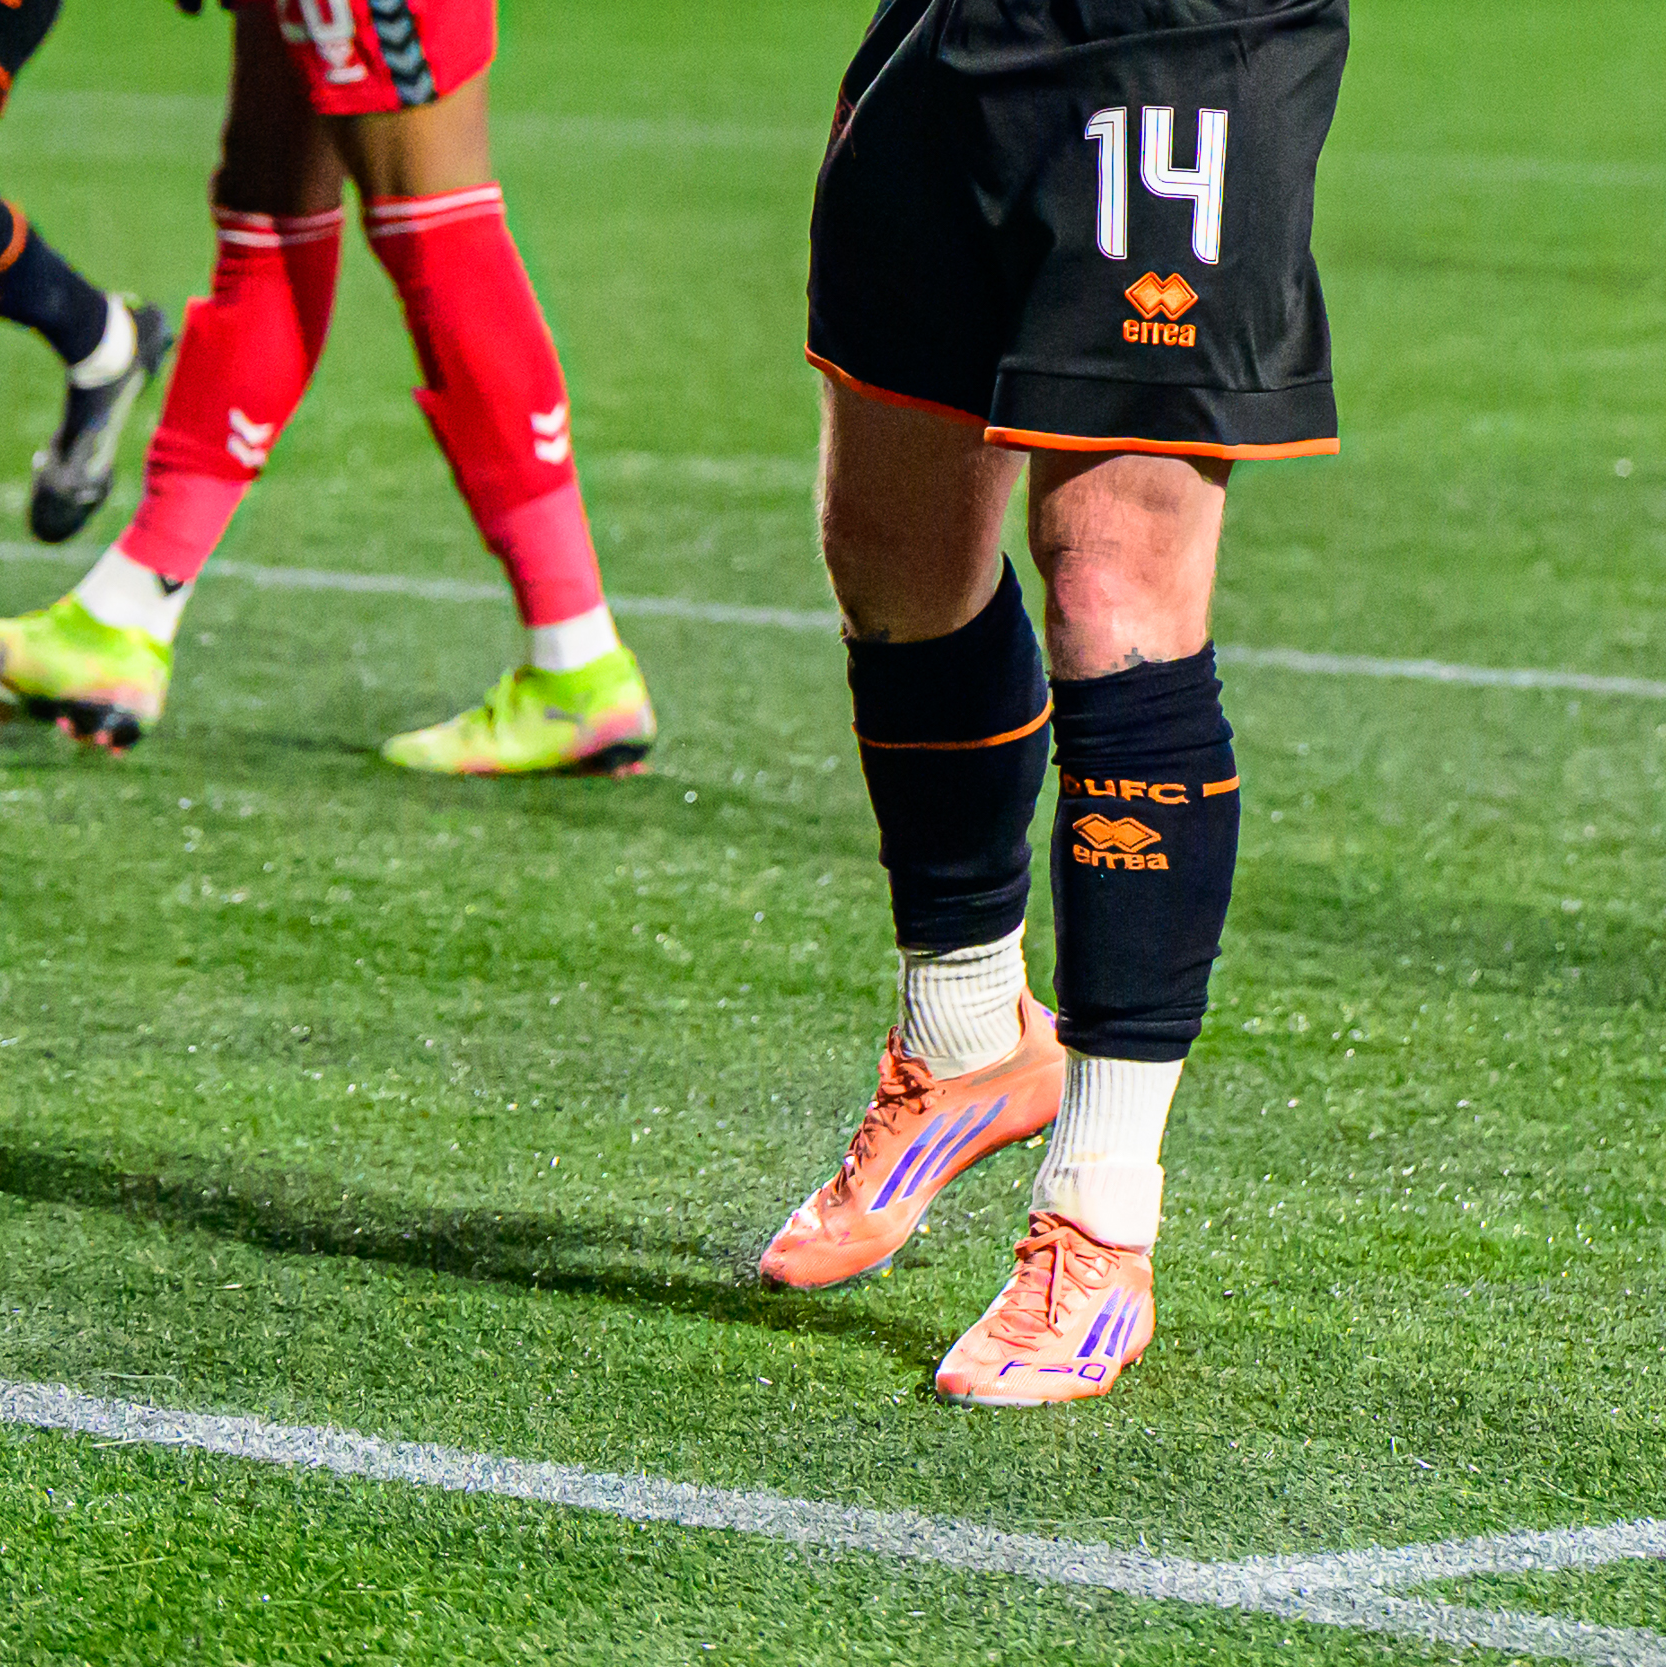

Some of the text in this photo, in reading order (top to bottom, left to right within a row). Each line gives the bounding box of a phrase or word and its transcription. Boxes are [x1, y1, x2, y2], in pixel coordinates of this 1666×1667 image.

[1084, 106, 1229, 265] 14
[1122, 318, 1197, 348] errea
[1063, 772, 1191, 805] DUFC
[1073, 843, 1170, 871] errea
